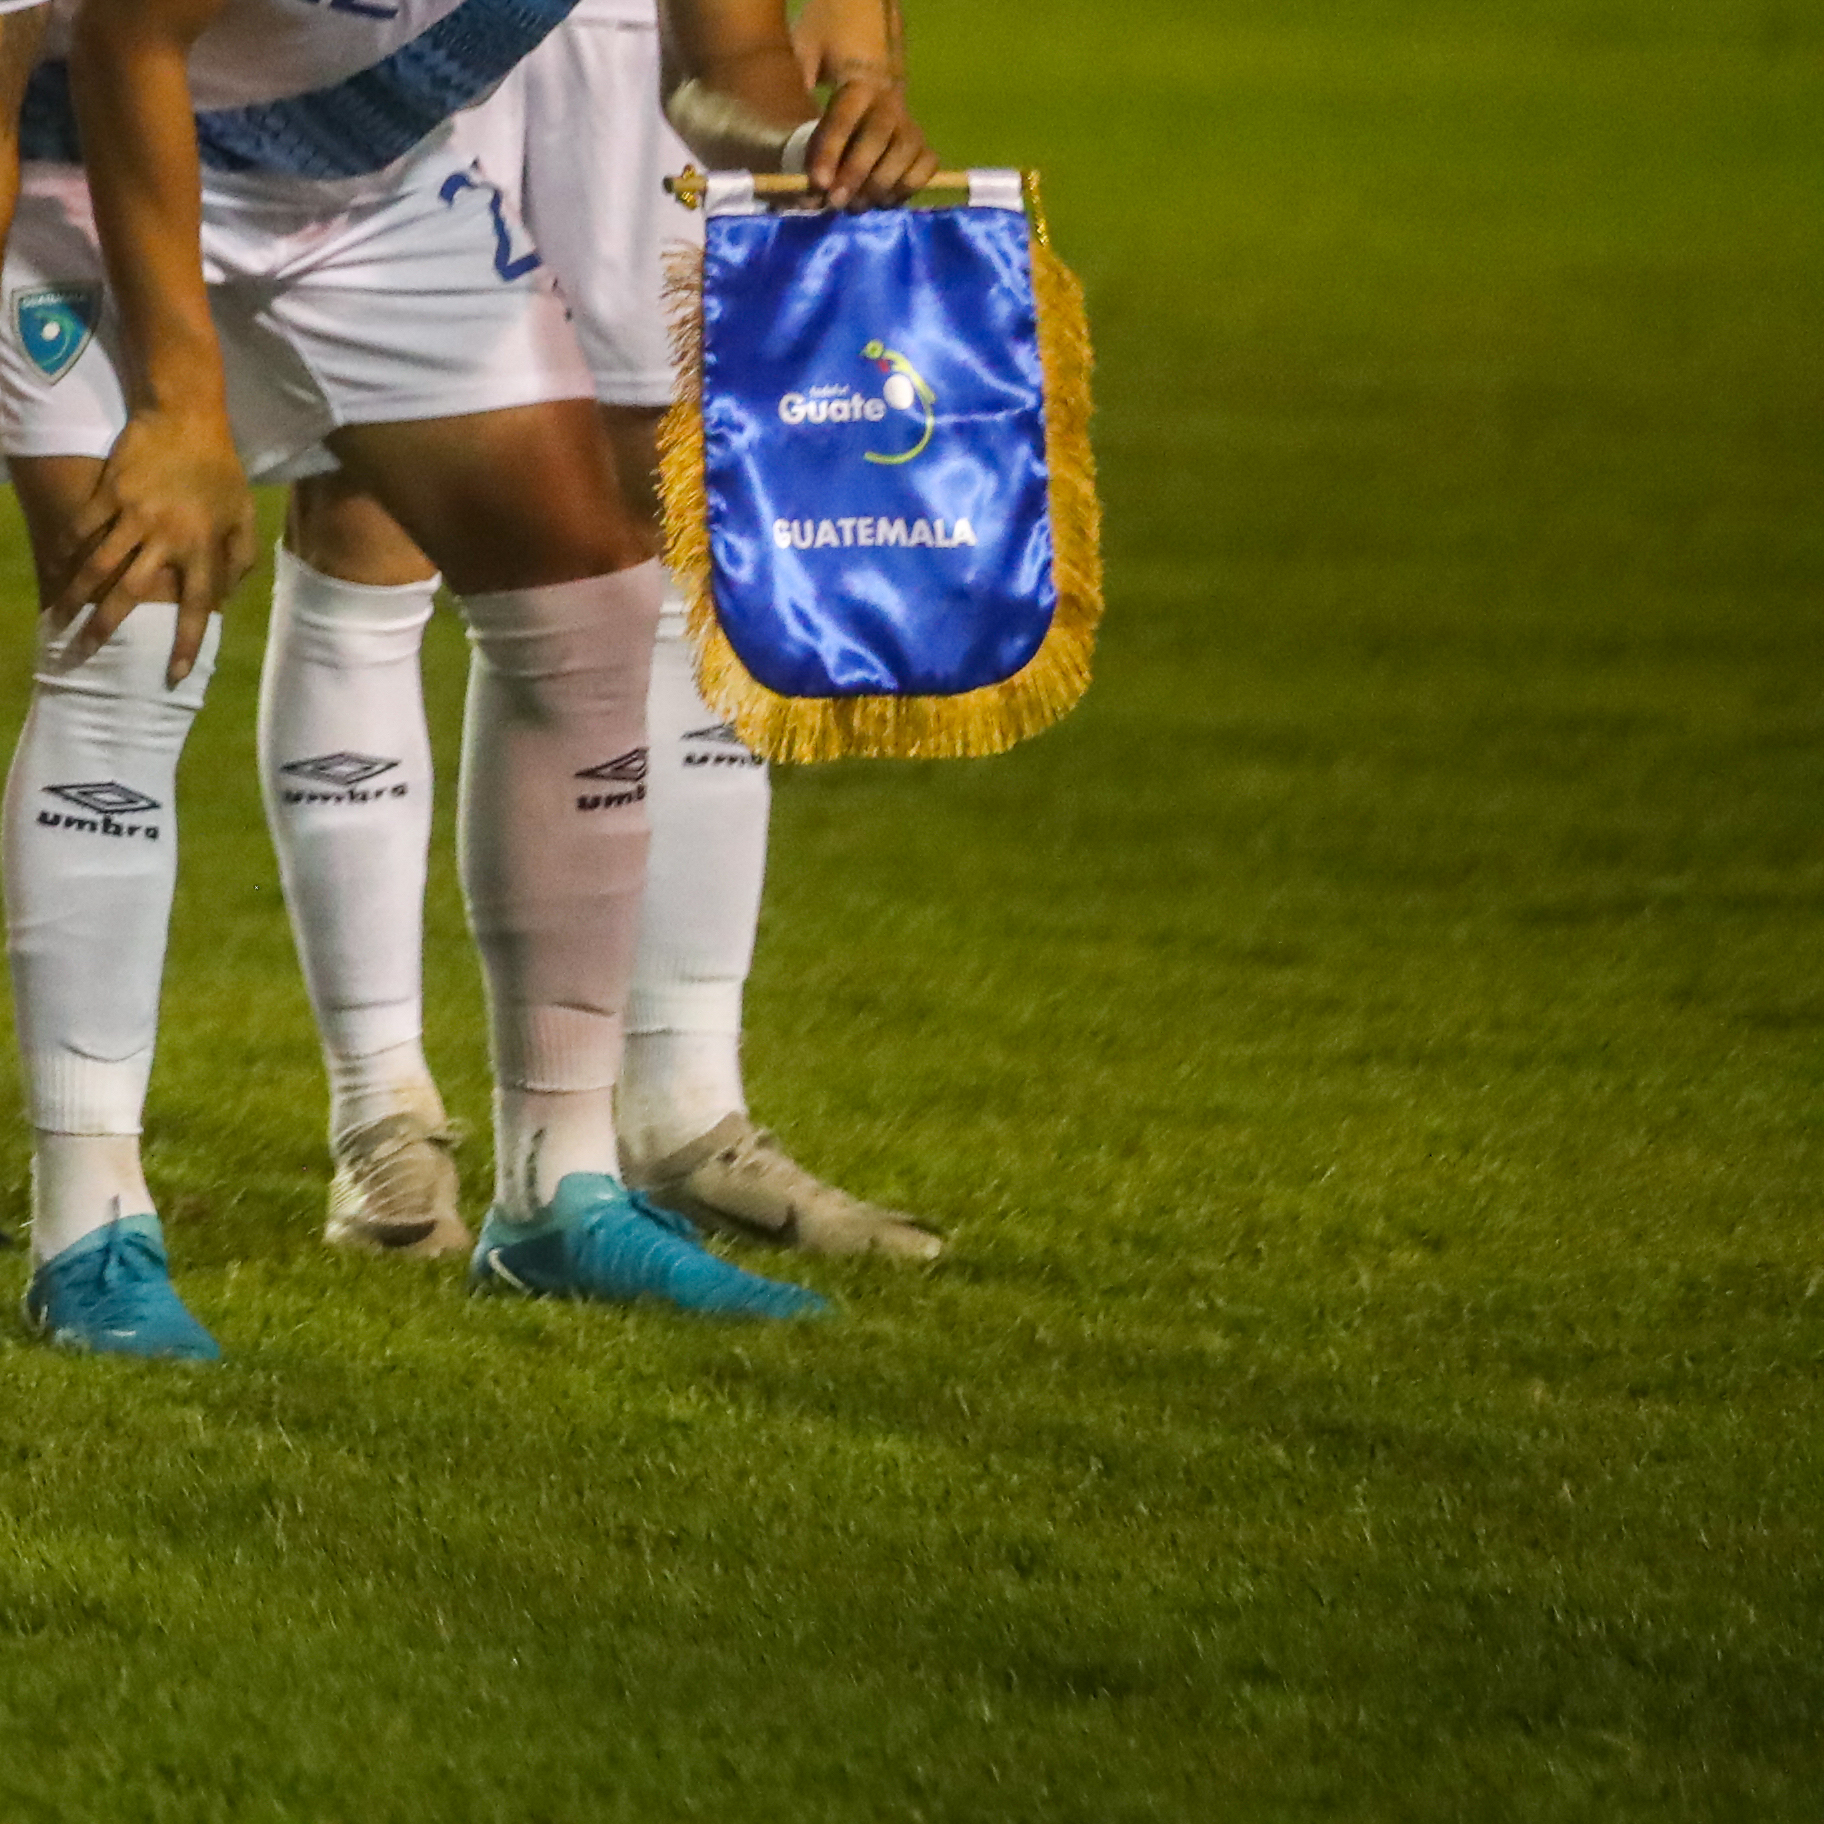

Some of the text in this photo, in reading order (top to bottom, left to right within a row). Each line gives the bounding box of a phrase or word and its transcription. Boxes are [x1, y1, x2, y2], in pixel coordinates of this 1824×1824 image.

[778, 391, 887, 424] Guate
[773, 517, 978, 550] GUATEMALA
[576, 784, 647, 812] umb
[36, 811, 160, 840] umbro
